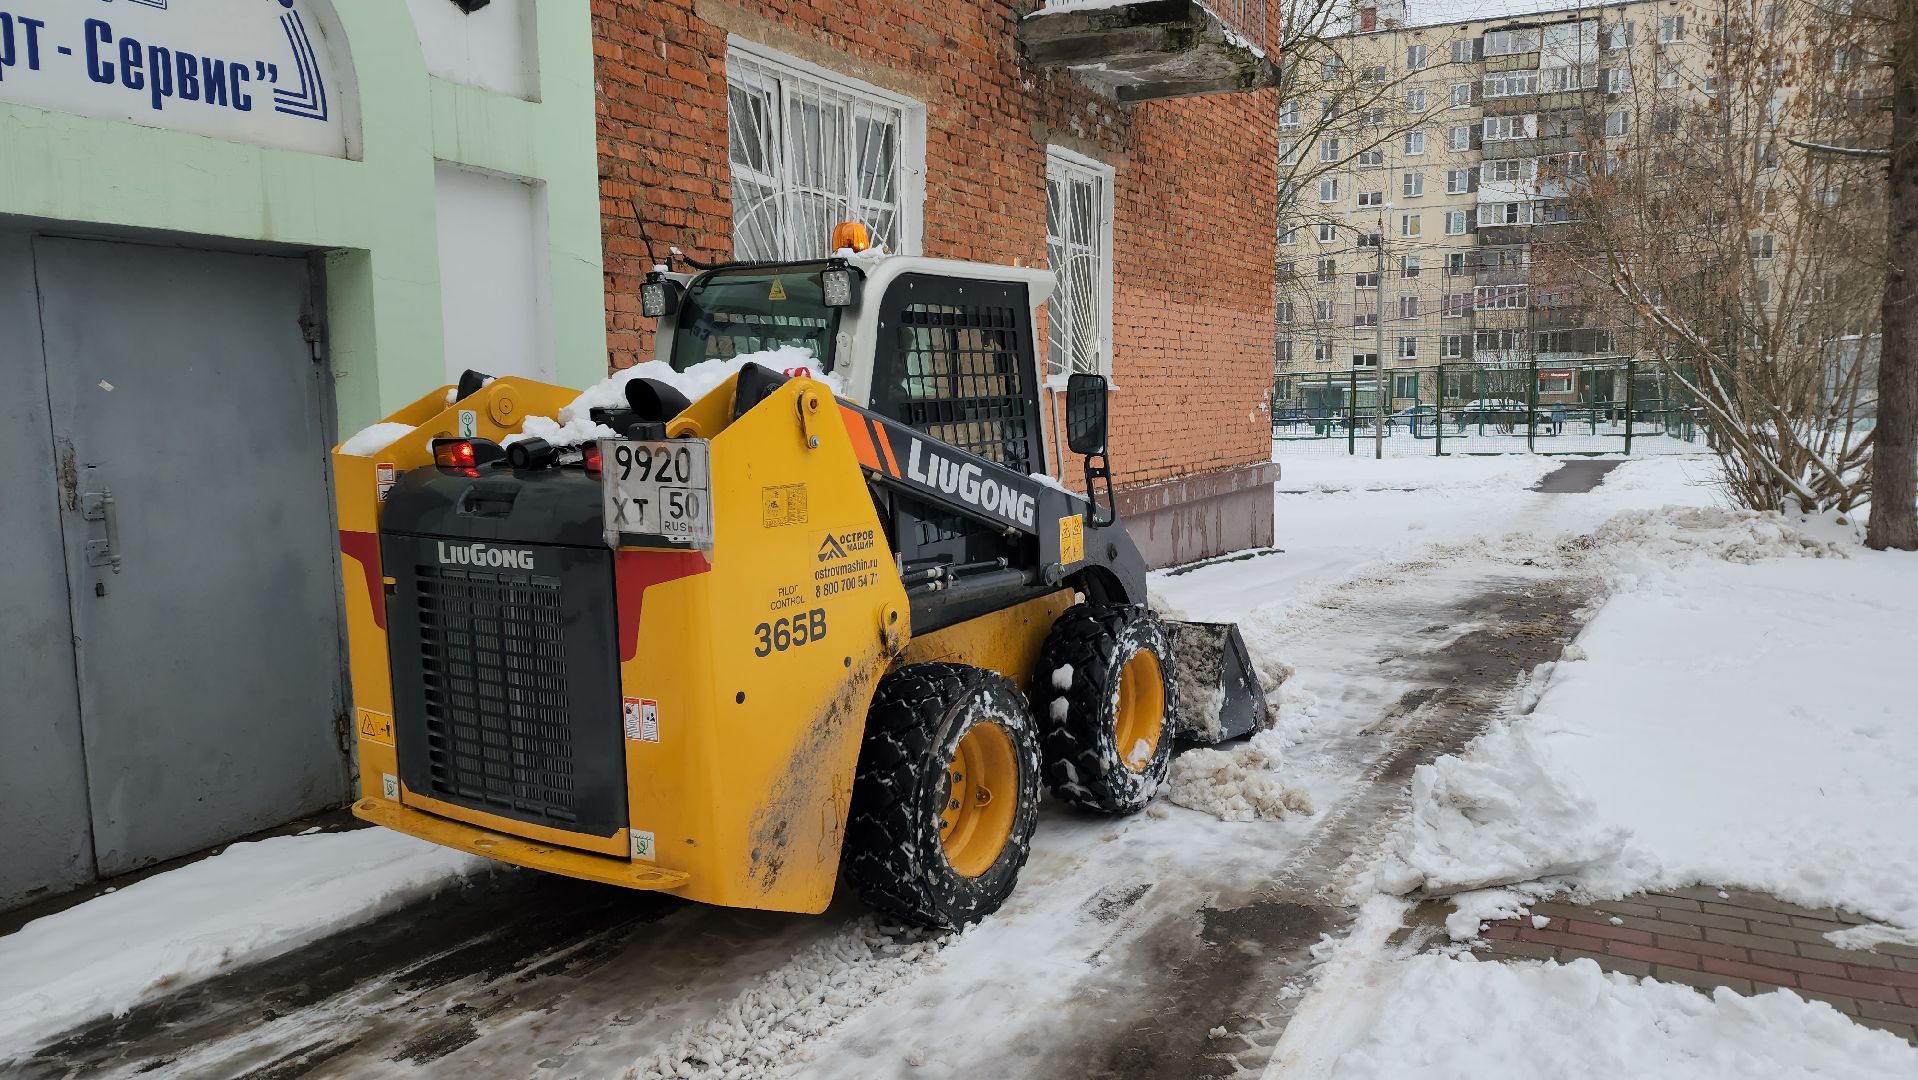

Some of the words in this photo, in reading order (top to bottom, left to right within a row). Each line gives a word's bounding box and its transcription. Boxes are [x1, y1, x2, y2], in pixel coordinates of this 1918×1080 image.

[615, 445, 691, 483] 9920
[669, 491, 700, 520] 50
[664, 520, 687, 532] RUS
[839, 530, 874, 544] ОСТРОВ
[846, 540, 874, 551] МАШИН
[815, 559, 878, 580] ostrovmashin.ru
[778, 584, 799, 597] PILOT
[815, 584, 821, 598] 8
[823, 580, 839, 597] 800
[840, 576, 856, 592] 700
[857, 574, 868, 588] 54
[770, 596, 805, 610] CONTROL
[754, 607, 827, 658] 365B
